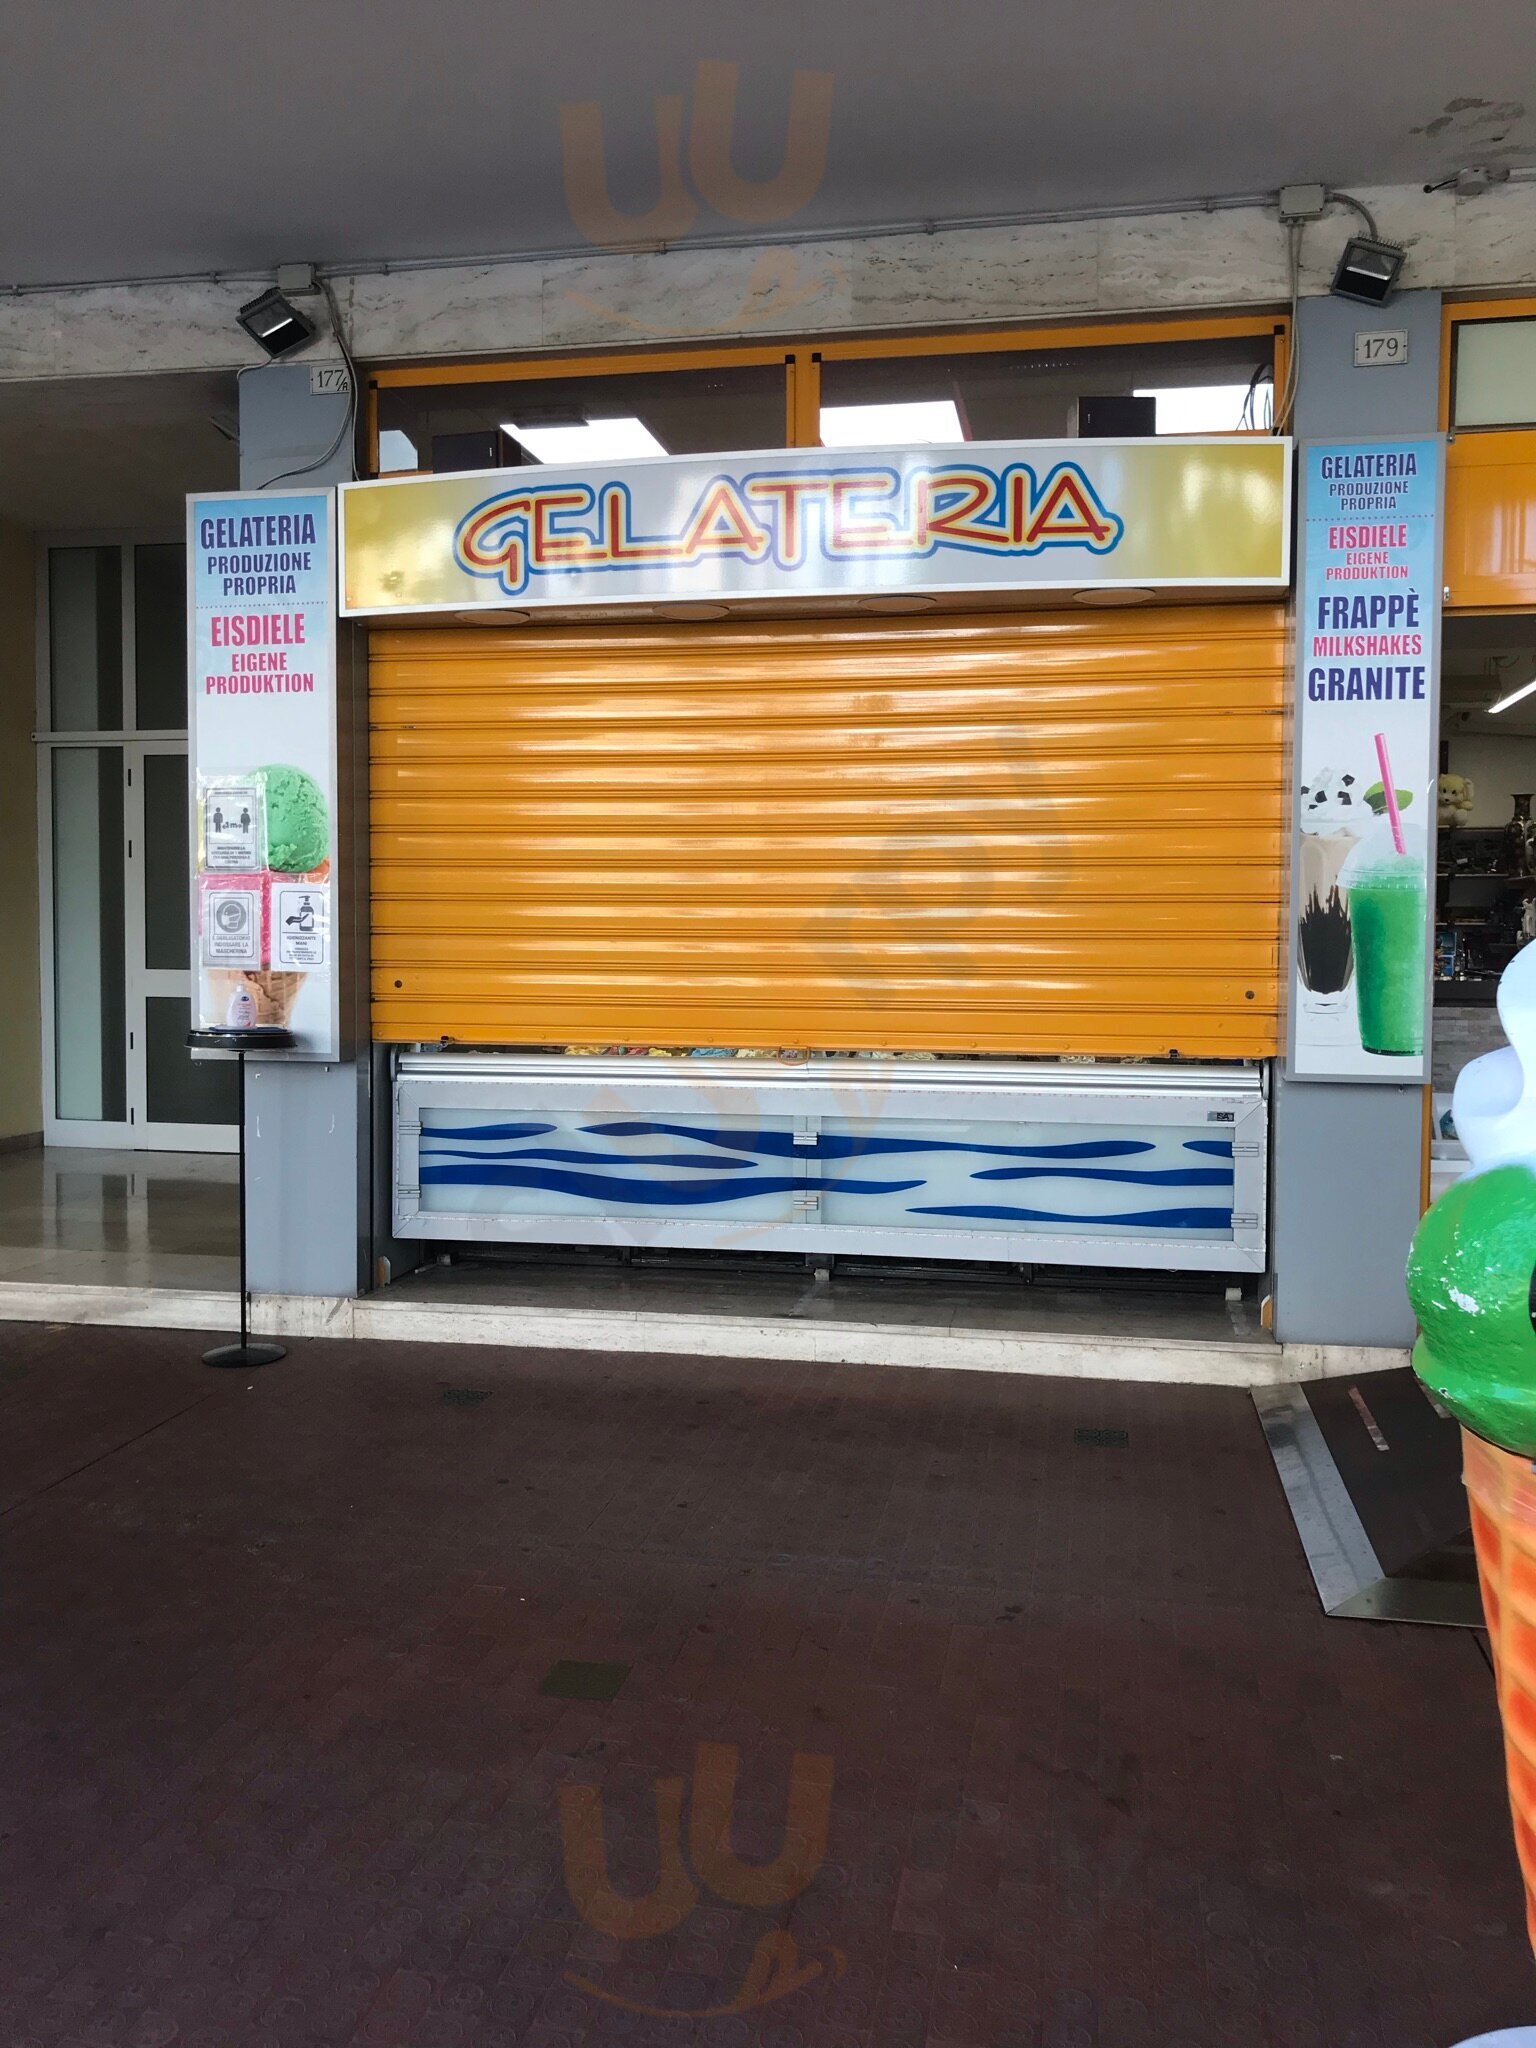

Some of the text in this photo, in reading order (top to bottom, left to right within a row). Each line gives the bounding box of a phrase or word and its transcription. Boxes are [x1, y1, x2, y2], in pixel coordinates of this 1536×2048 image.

[1364, 337, 1399, 359] 179
[1321, 453, 1417, 480] GELATERIA
[1329, 481, 1409, 497] PRODUZIONE
[1340, 496, 1397, 511] PROPRIA
[200, 513, 316, 550] GELATERIA
[454, 462, 1123, 595] GELATERIA
[1328, 524, 1407, 550] EISDIELE
[207, 552, 311, 575] PRODUZIONE
[1346, 551, 1389, 565] EIGENE
[1325, 566, 1408, 581] PRODUKTION
[223, 575, 296, 596] PROPRIA
[1317, 588, 1420, 630] FRAPPÈ
[210, 613, 305, 647] EISDIELE
[1313, 634, 1422, 657] MILKSHAKES
[231, 652, 287, 673] EIGENE
[205, 673, 314, 695] PRODUKTION
[1307, 666, 1426, 702] GRANITE
